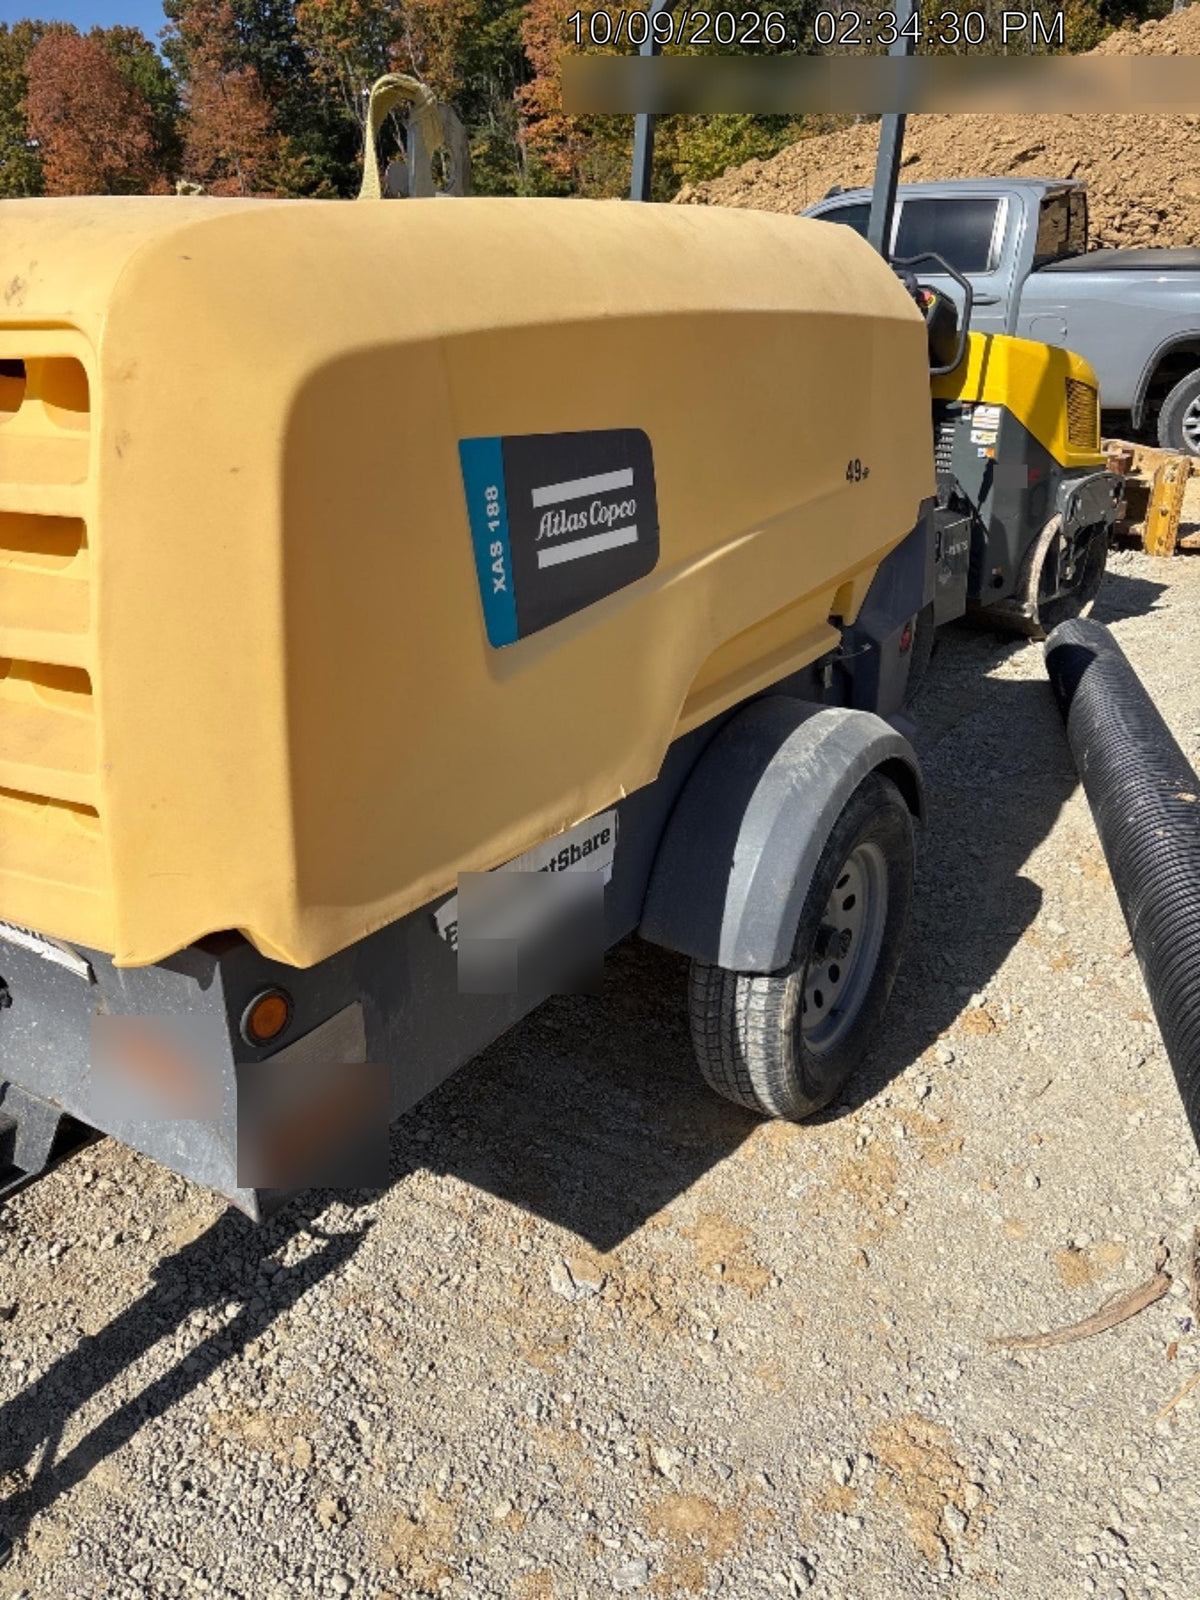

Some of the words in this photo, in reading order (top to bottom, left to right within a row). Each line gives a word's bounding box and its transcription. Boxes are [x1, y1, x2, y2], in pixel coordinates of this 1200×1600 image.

[485, 486, 500, 531] 188
[535, 508, 588, 540] Atlas
[590, 500, 636, 526] Copco
[490, 541, 506, 593] XAS
